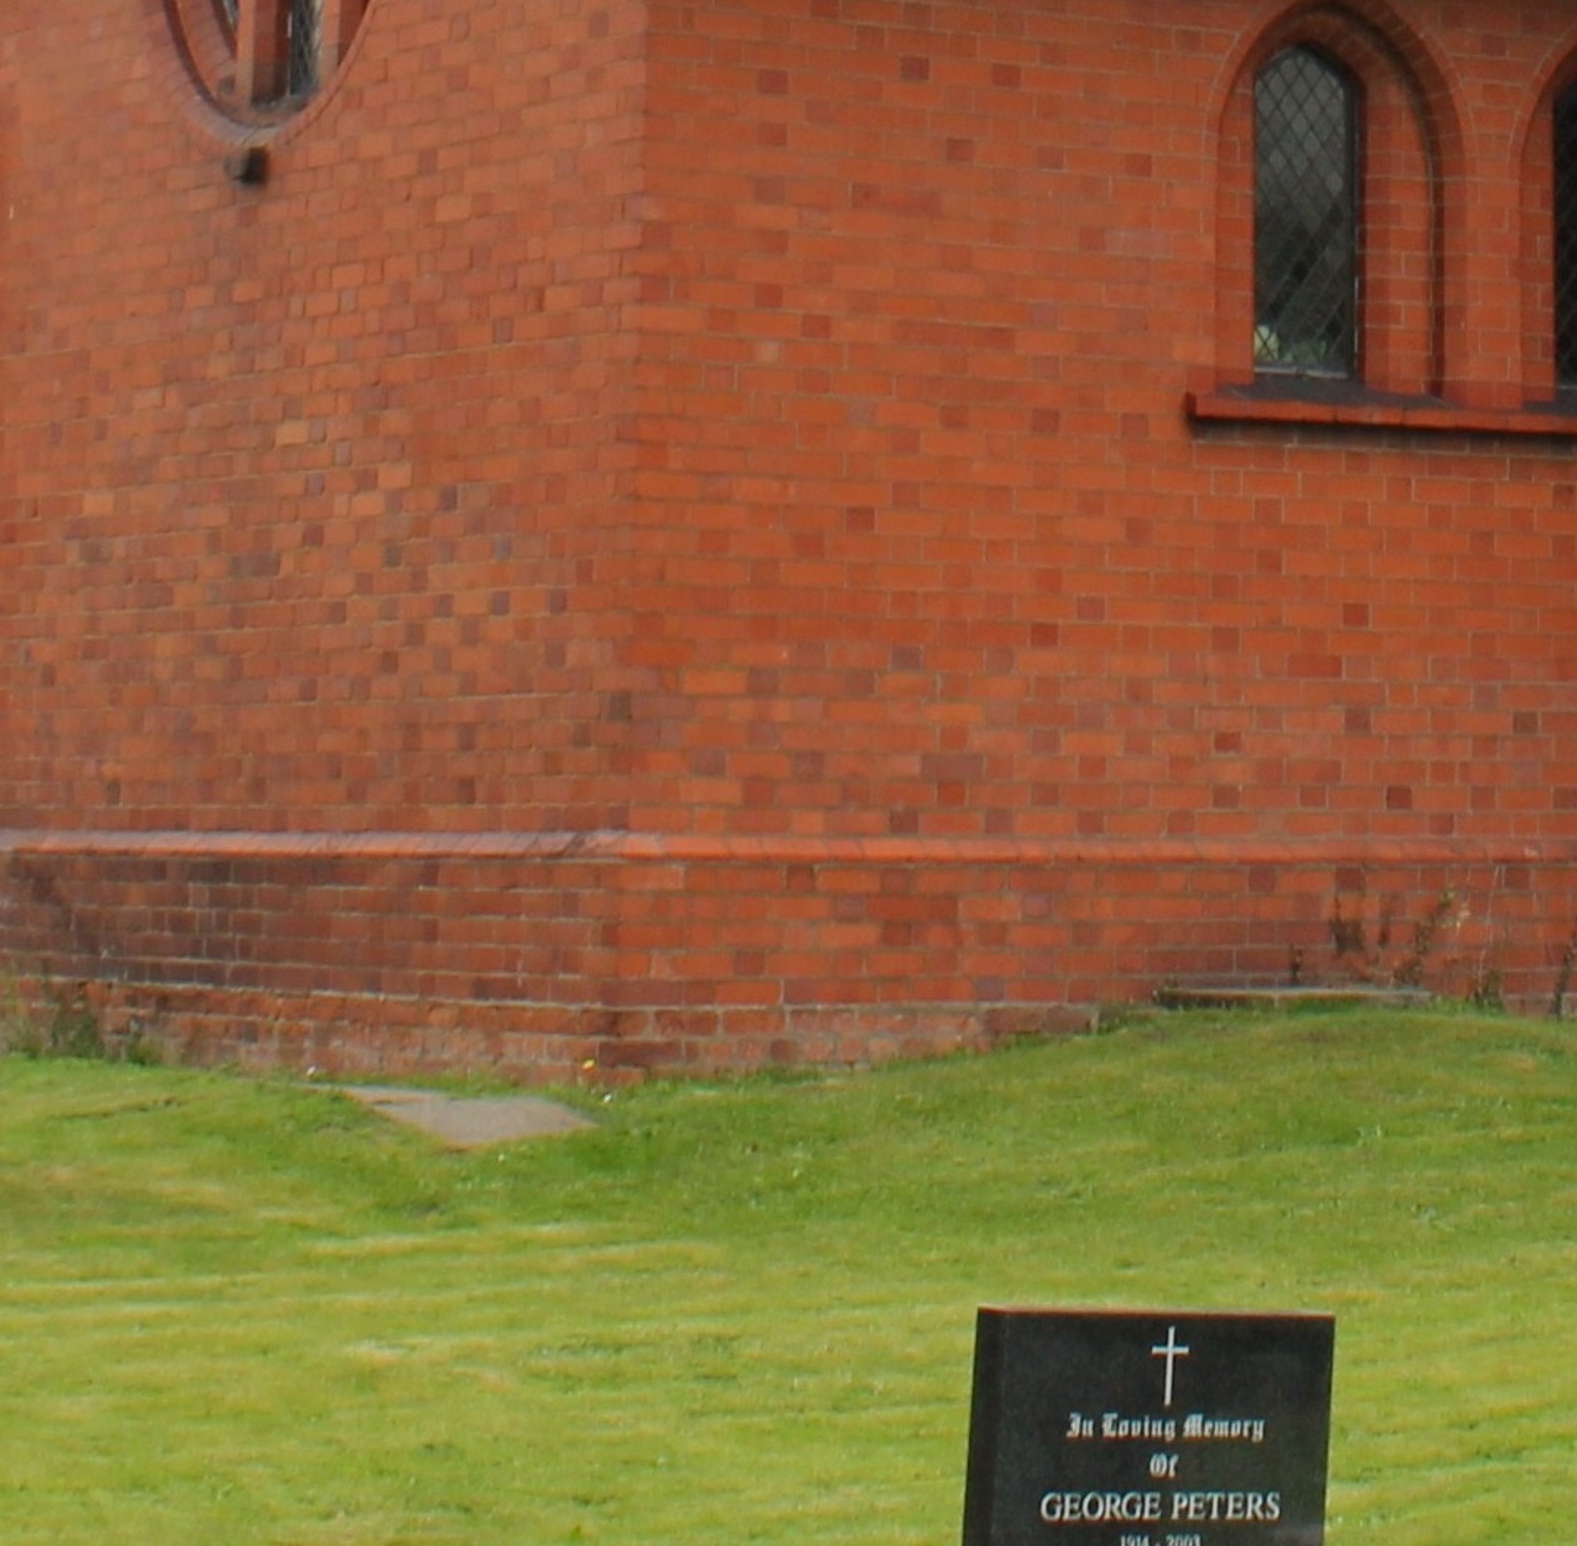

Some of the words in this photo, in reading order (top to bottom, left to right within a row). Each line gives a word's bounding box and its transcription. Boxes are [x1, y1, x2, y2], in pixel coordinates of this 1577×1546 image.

[1066, 1412, 1094, 1439] In
[1101, 1412, 1176, 1442] Loving
[1183, 1412, 1266, 1444] Memory
[1149, 1453, 1179, 1478] Of
[1040, 1491, 1162, 1522] GEORGE
[1170, 1491, 1281, 1522] PETERS
